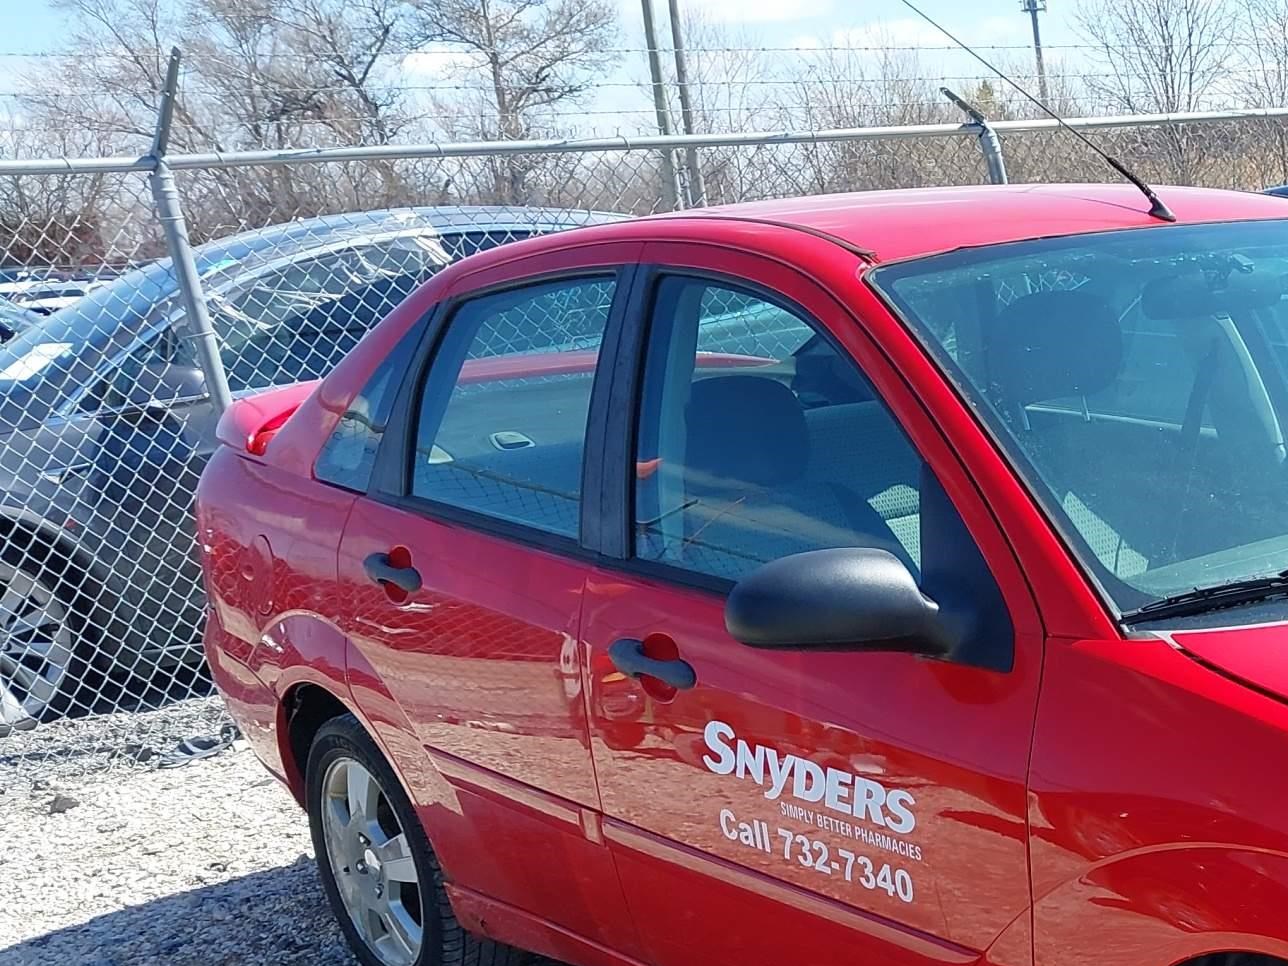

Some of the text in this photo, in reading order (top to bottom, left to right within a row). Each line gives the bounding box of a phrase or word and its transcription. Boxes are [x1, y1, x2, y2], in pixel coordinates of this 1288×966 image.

[703, 720, 916, 833] SNYDERS
[719, 808, 914, 903] Call 732-7340
[780, 801, 922, 861] SIMPLY BETTER PHARMACIES
